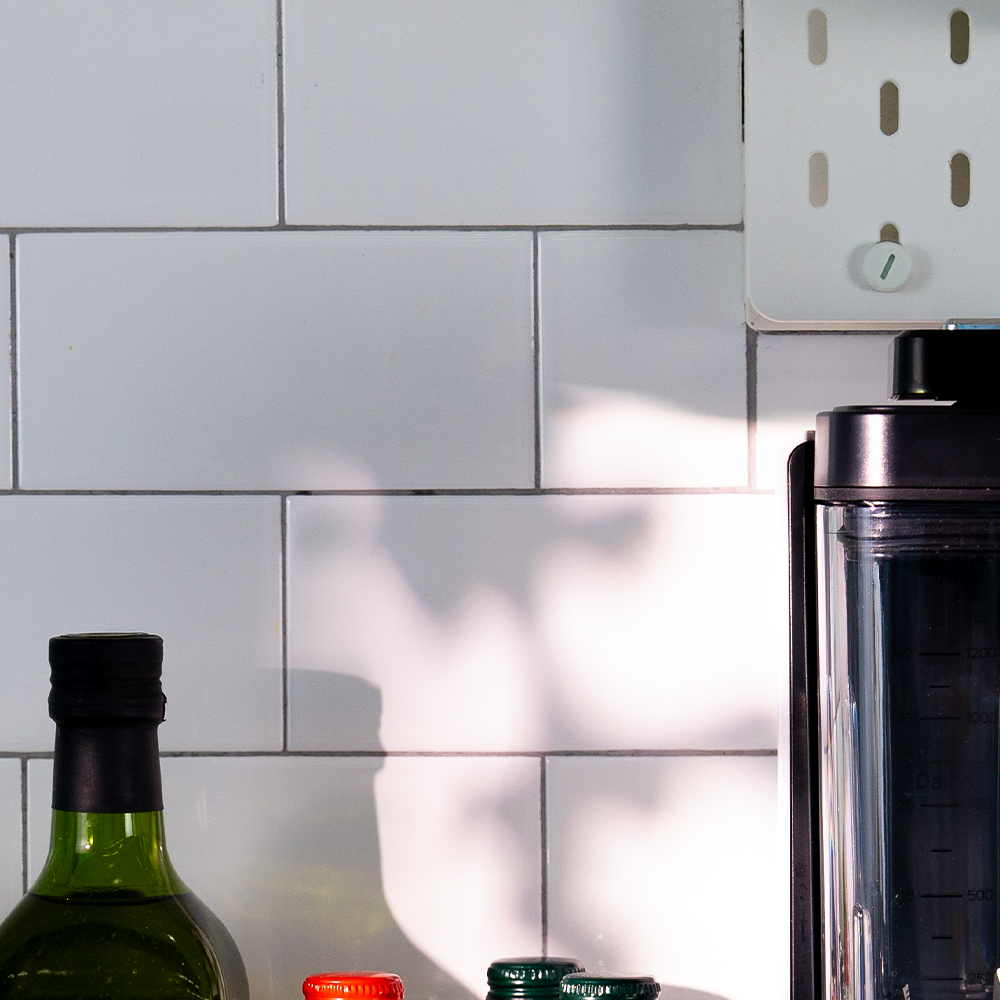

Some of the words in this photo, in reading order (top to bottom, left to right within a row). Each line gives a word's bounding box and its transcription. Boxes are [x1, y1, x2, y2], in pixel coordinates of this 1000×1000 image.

[965, 647, 997, 660] 1200
[966, 712, 997, 724] 1000
[967, 889, 994, 902] 500
